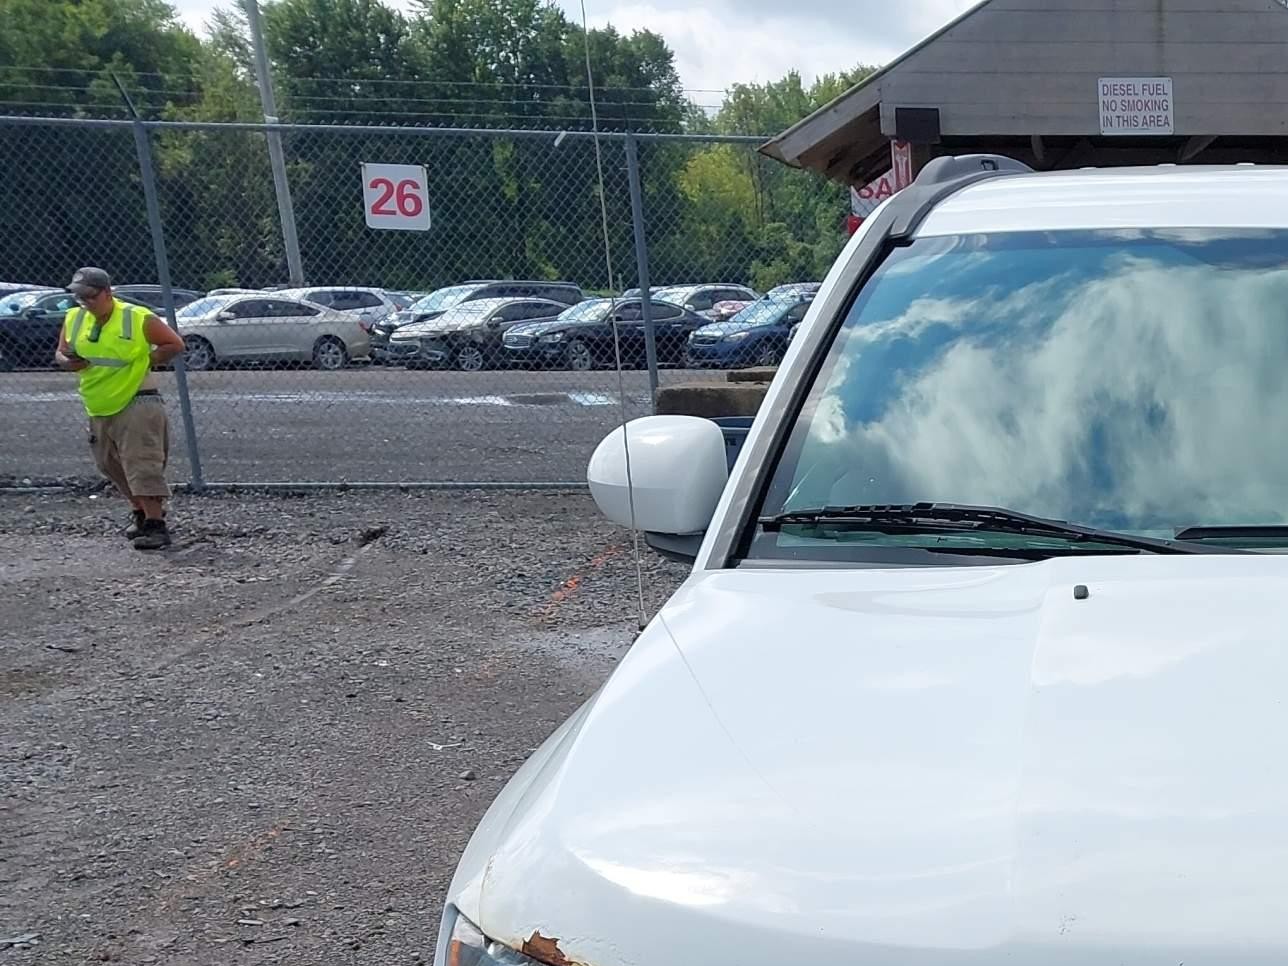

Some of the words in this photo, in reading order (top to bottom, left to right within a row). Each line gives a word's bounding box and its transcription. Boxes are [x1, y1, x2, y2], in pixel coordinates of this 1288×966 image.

[1102, 83, 1139, 96] DIESEL
[1141, 83, 1168, 96] FUEL
[1102, 99, 1117, 112] NO
[1120, 99, 1169, 112] SMOKING
[1102, 115, 1113, 127] IN
[1116, 115, 1139, 127] THIS
[1141, 115, 1170, 127] AREA
[369, 178, 423, 217] 26
